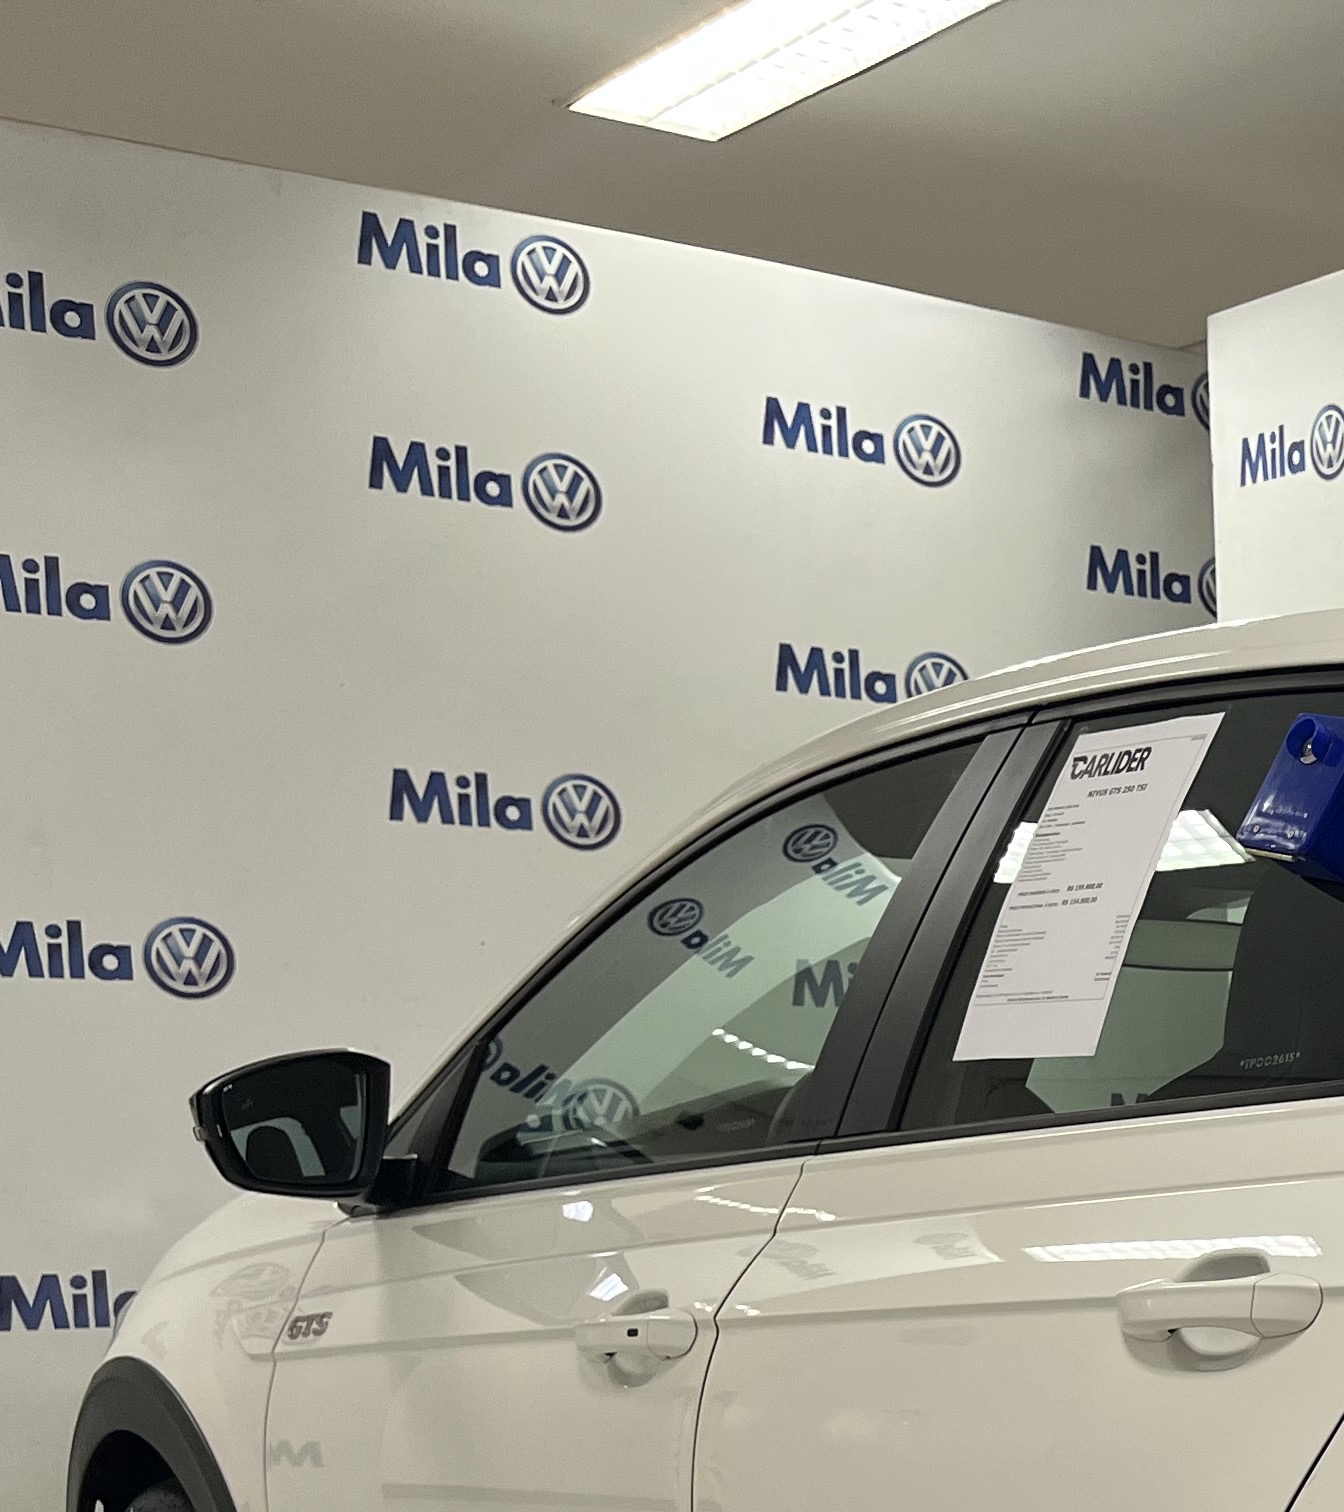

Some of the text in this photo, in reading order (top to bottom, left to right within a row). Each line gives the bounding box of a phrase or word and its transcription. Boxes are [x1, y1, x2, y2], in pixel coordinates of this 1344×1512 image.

[357, 211, 502, 288] Mila
[0, 270, 96, 341] ila
[1080, 352, 1186, 417] Mila
[762, 397, 885, 464] Mila
[1240, 425, 1306, 487] Mila
[368, 435, 514, 508] Mila
[1086, 545, 1192, 604] Mila
[776, 643, 898, 703] Mila
[1070, 747, 1152, 780] CARLIDER
[389, 768, 534, 831] Mila
[0, 1269, 138, 1331] Mil
[287, 1311, 334, 1340] GTS
